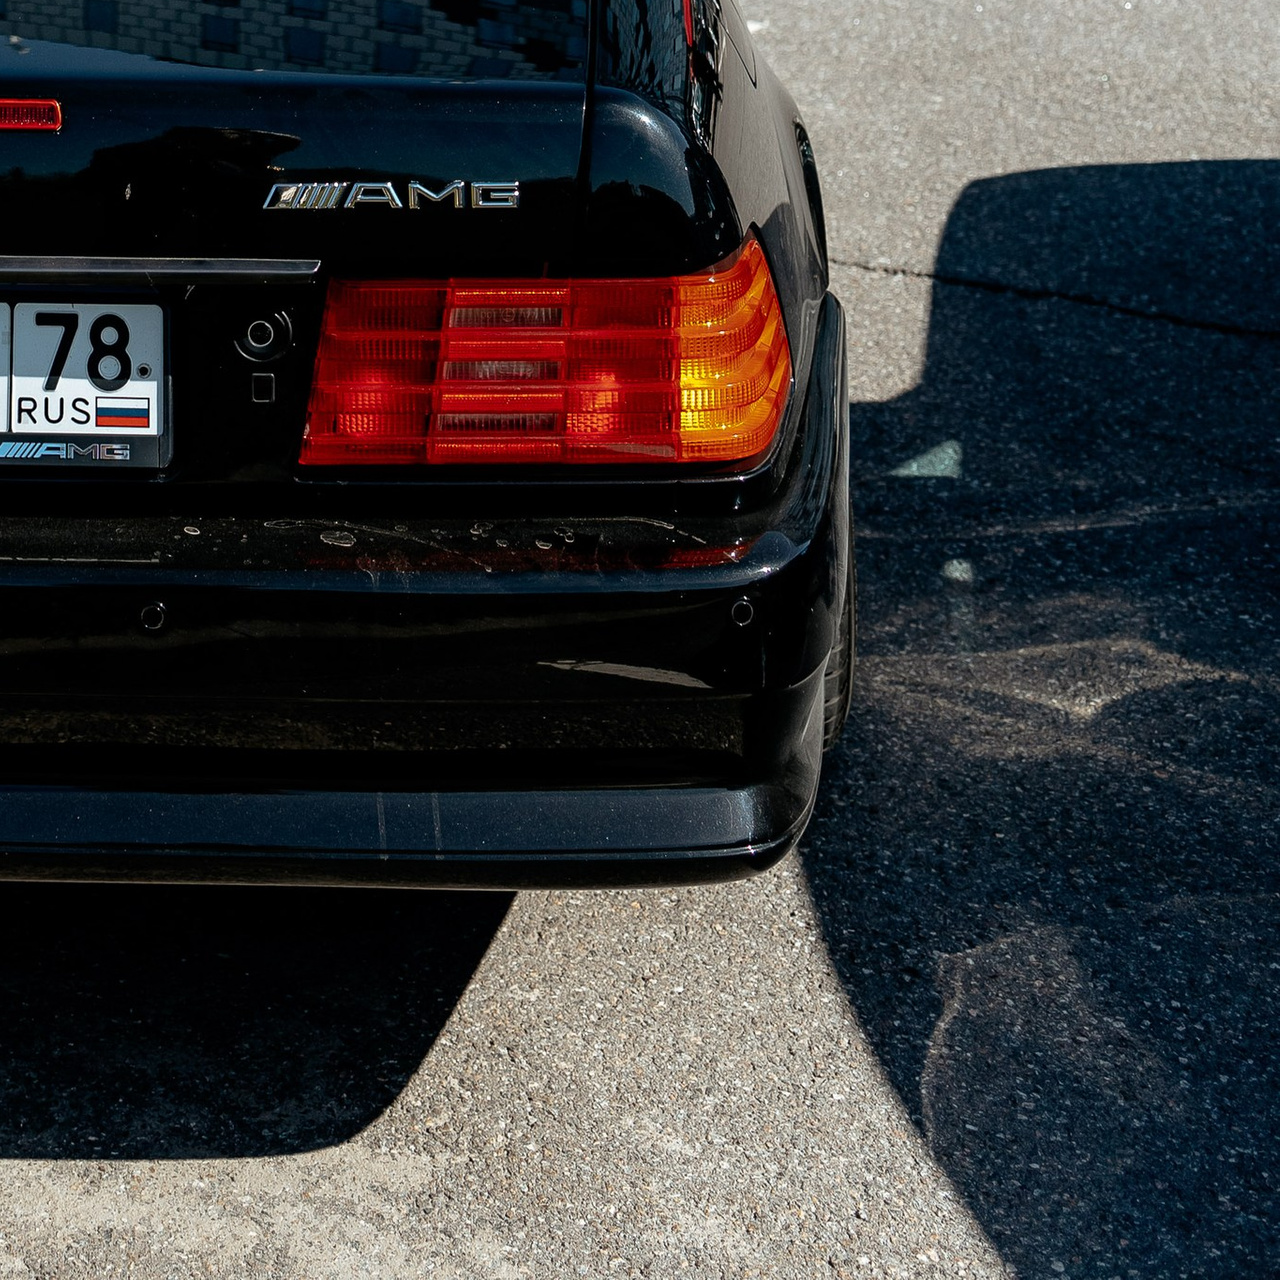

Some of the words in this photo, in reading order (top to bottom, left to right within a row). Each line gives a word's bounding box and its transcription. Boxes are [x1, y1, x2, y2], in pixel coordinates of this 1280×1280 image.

[344, 180, 519, 209] AMG
[35, 312, 133, 392] 78
[17, 396, 91, 425] RUS
[33, 442, 130, 461] AMG
